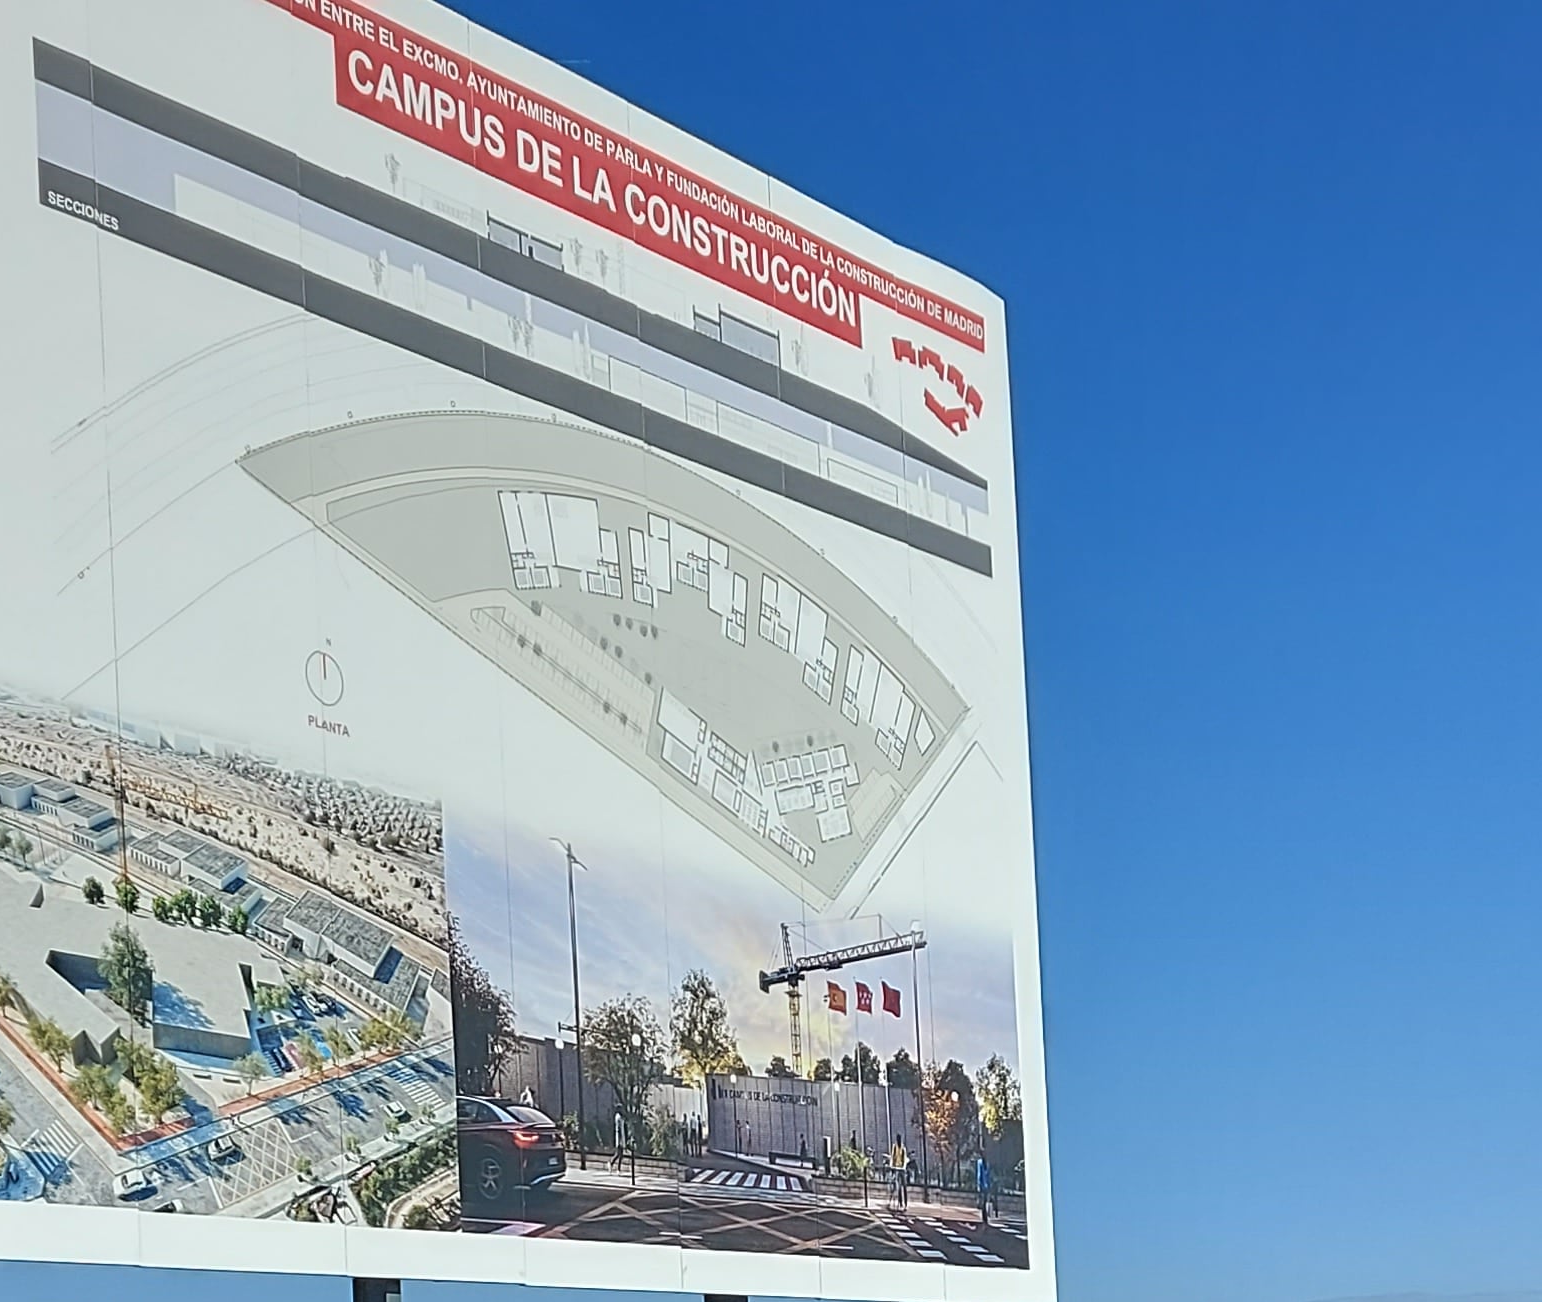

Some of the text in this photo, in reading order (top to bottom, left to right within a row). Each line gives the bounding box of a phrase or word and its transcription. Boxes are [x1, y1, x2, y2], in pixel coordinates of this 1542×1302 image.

[47, 190, 120, 231] SECCIONES
[320, 0, 375, 43] ENTRE
[378, 26, 400, 53] EL
[402, 38, 463, 85] EXCMO.
[467, 71, 581, 141] AYUNTAMIENTO
[584, 127, 603, 153] DE
[606, 139, 653, 178] PARLA
[654, 163, 664, 183] Y
[666, 167, 739, 223] FUNDACIÓN
[741, 207, 800, 251] LABORAL
[801, 236, 819, 260] DE
[819, 245, 835, 269] LA
[836, 256, 925, 313] CONSTRUCCIÓN
[927, 300, 943, 321] DE
[943, 307, 984, 340] MADRID
[347, 49, 857, 328] CAMPUS DE LA CONSTRUCCIÓN
[307, 714, 351, 738] PLANTA
